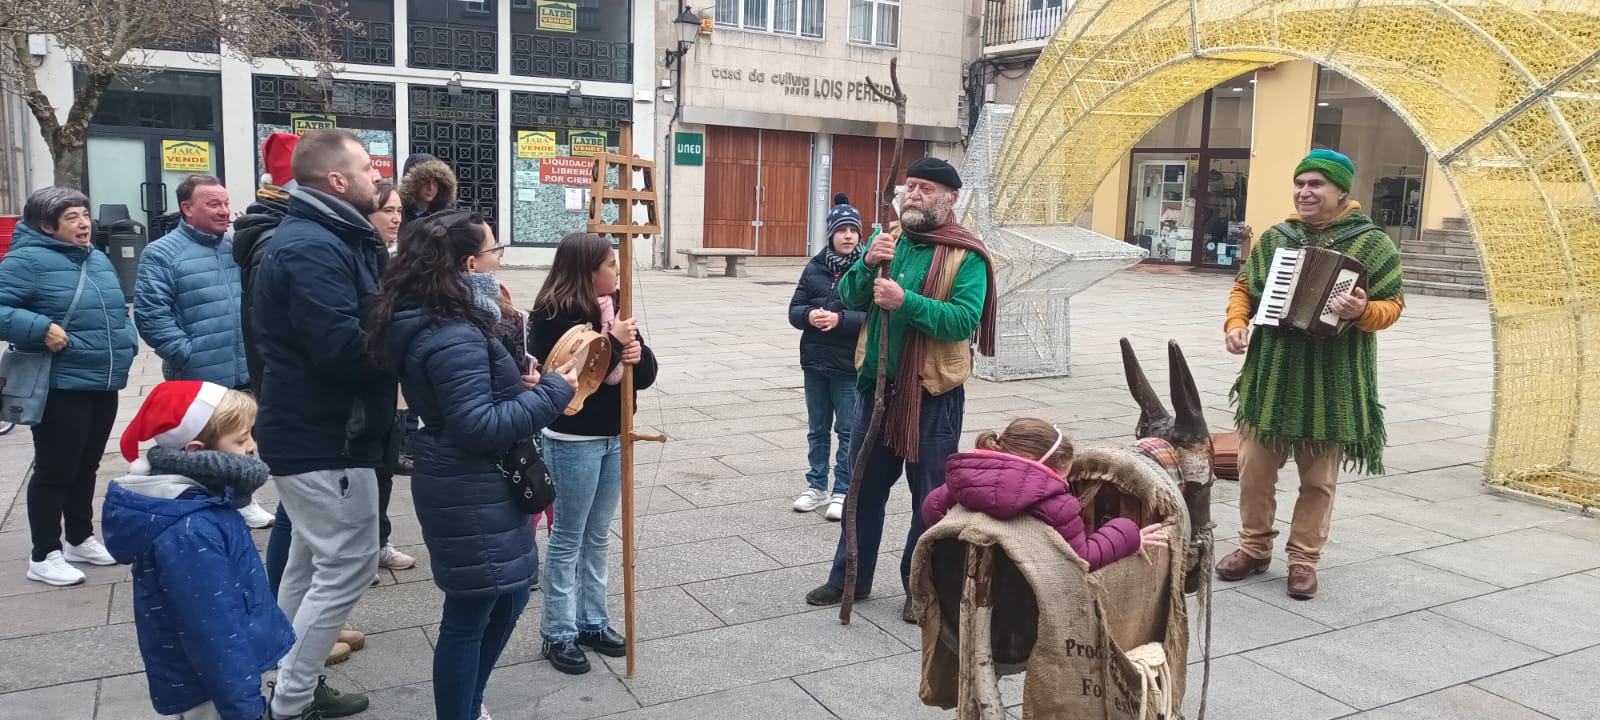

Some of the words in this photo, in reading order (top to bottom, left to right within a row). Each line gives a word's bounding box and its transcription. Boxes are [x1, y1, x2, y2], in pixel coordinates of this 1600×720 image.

[542, 8, 572, 17] LAYBE
[542, 17, 571, 25] VENDE
[712, 67, 742, 80] casa
[749, 69, 765, 83] da
[771, 72, 810, 87] cultura
[814, 78, 842, 99] LOIS
[525, 137, 549, 145] JARA
[574, 137, 602, 145] LAYBE
[172, 147, 201, 155] JARA
[677, 144, 701, 154] UNED
[543, 158, 593, 168] LIQUIDACI
[544, 175, 564, 183] POR
[567, 176, 592, 185] CIER
